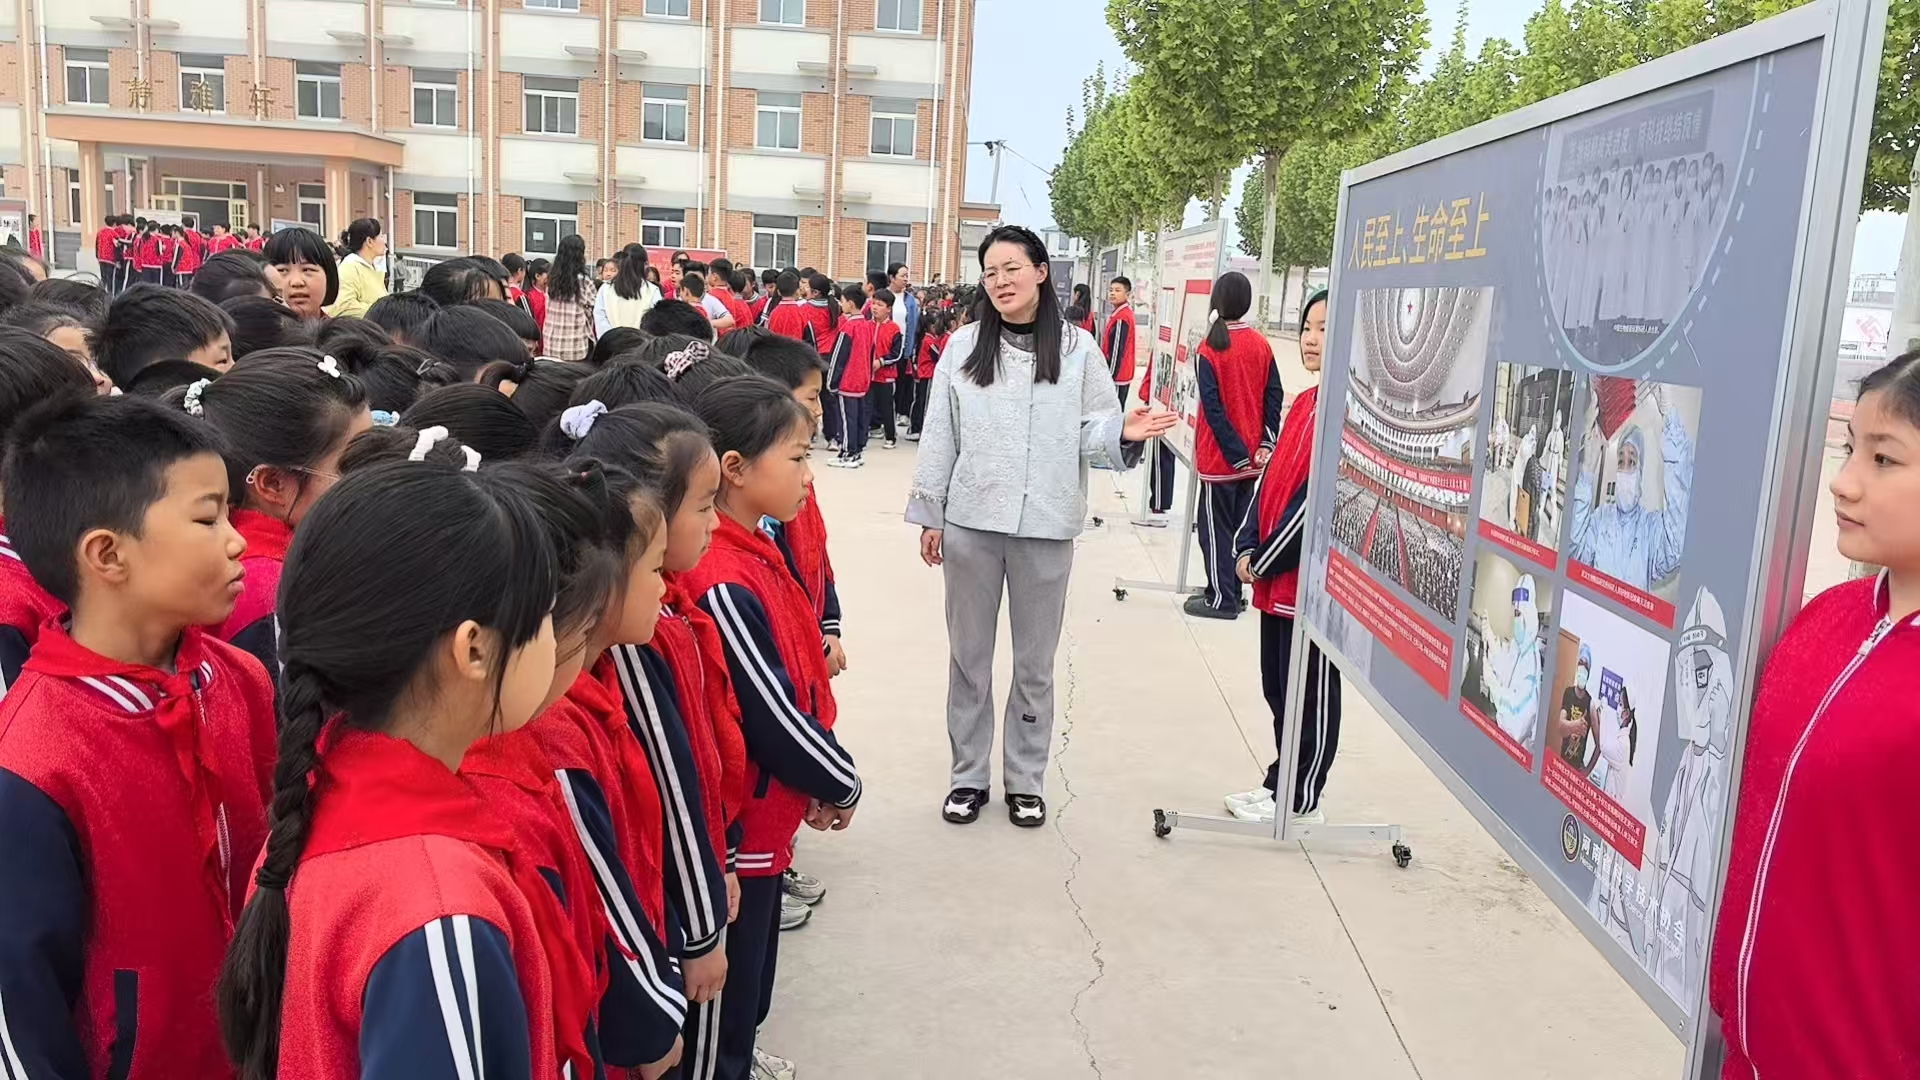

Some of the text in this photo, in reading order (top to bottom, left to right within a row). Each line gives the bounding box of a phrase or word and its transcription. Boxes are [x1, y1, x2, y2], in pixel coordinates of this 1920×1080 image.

[128, 77, 274, 118] 静雅轩
[1348, 191, 1490, 270] 人民至上、生命至上
[1581, 832, 1685, 942] 河南省科学技术协会
